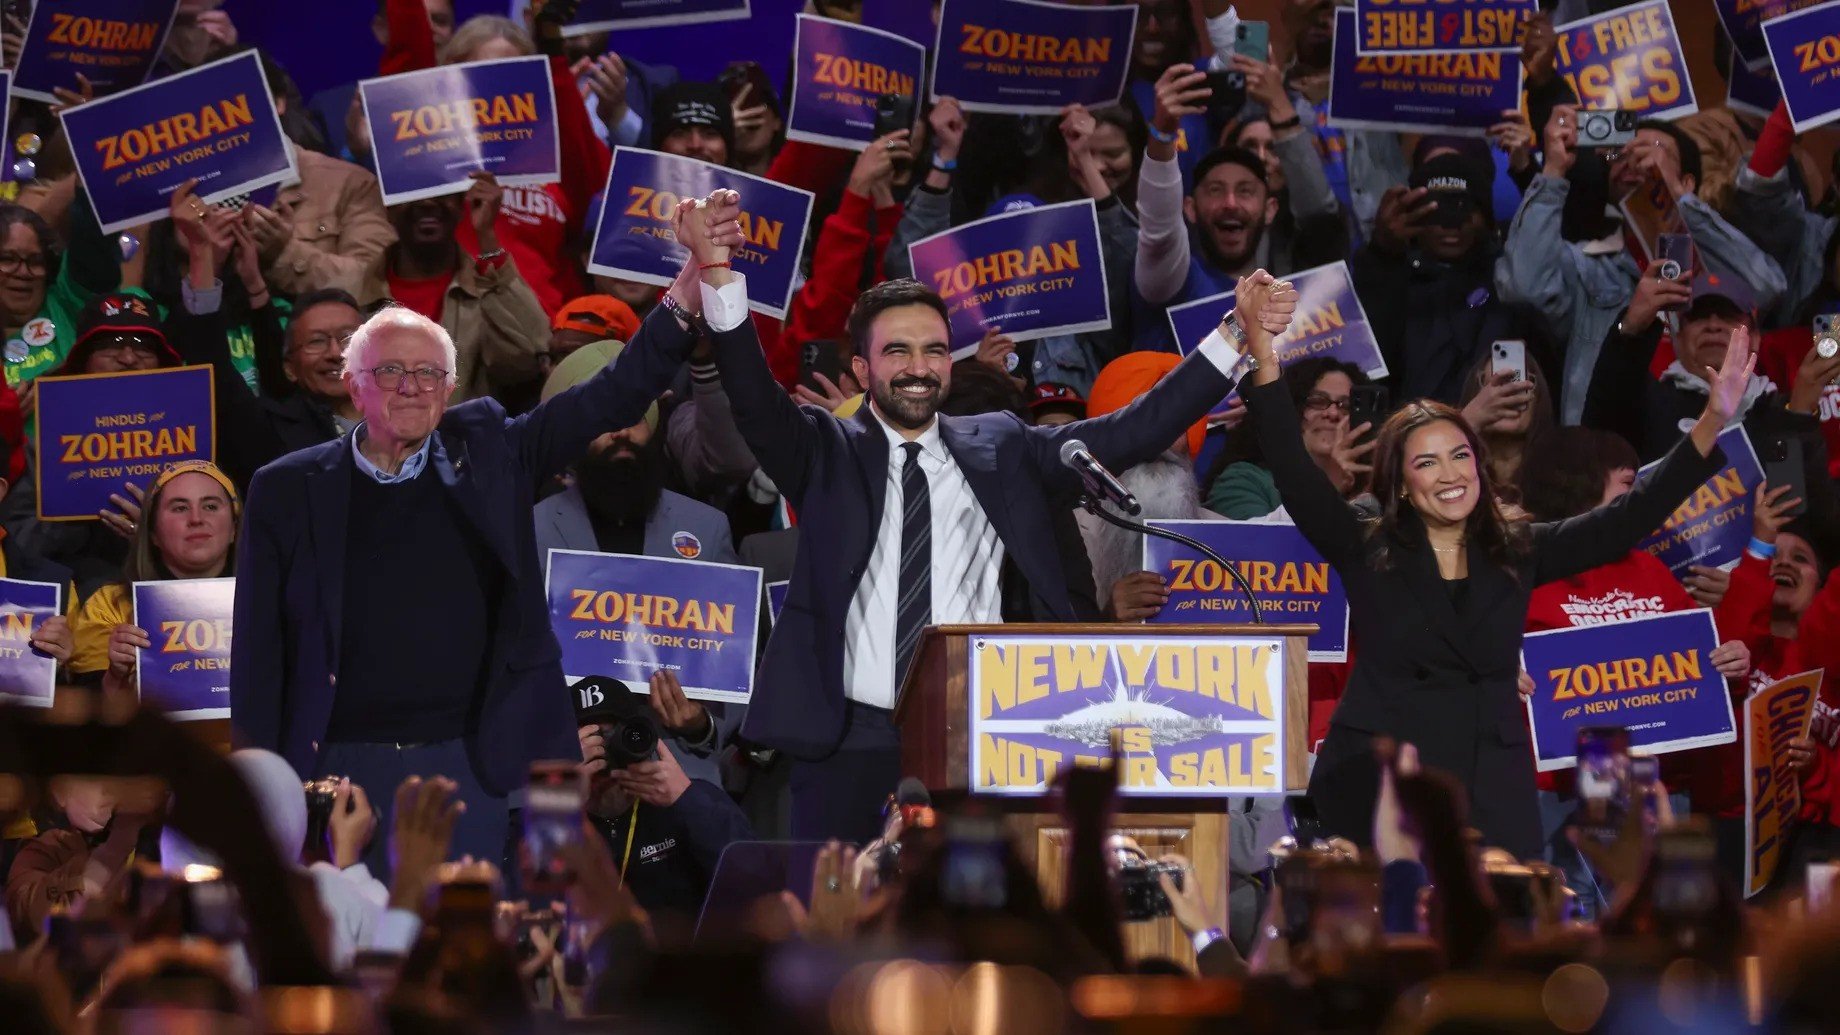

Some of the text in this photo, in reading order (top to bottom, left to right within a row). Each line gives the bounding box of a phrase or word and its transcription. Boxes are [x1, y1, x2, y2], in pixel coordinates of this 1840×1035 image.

[47, 13, 159, 51] ZOHRAN
[960, 24, 1112, 62] ZOHRAN
[1366, 11, 1434, 47] FREE
[1593, 6, 1667, 55] FREE
[813, 52, 914, 95] ZOHRAN
[1564, 47, 1681, 110] SES
[95, 94, 254, 171] ZOHRAN
[391, 92, 538, 142] ZOHRAN
[504, 129, 533, 141] CITY
[135, 158, 171, 178] NEW
[173, 144, 215, 166] YORK
[217, 132, 250, 152] CITY
[624, 186, 784, 250] ZOAN
[652, 228, 676, 240] NE
[934, 240, 1080, 299] ZOHRAN
[963, 291, 993, 309] NEW
[996, 283, 1037, 299] YORK
[1040, 276, 1075, 292] CITY
[1281, 335, 1342, 361] ORK CITY
[95, 413, 146, 427] HINDUS
[60, 426, 197, 463] ZOHRAN
[89, 467, 123, 479] NEW
[126, 464, 161, 476] YORK
[1169, 559, 1329, 593] ZOHRAN
[571, 589, 736, 635] ZOHRAN
[1174, 600, 1196, 612] FOR
[1201, 599, 1237, 610] NEW
[1287, 601, 1321, 612] CITY
[1560, 596, 1664, 615] EMOCRATIC
[161, 619, 232, 652] ZOH
[575, 629, 724, 652] FOR NEW YORK CITY
[980, 644, 1276, 721] NEW YORK
[1549, 649, 1702, 702] ZOHRAN
[1585, 699, 1618, 714] NEW
[1621, 692, 1661, 709] YORK
[1664, 687, 1697, 702] CITY
[1110, 727, 1152, 752] IS
[980, 732, 1062, 787] NOT
[1169, 733, 1276, 787] SALE
[1754, 768, 1777, 877] ALL
[640, 838, 676, 858] Bernie
